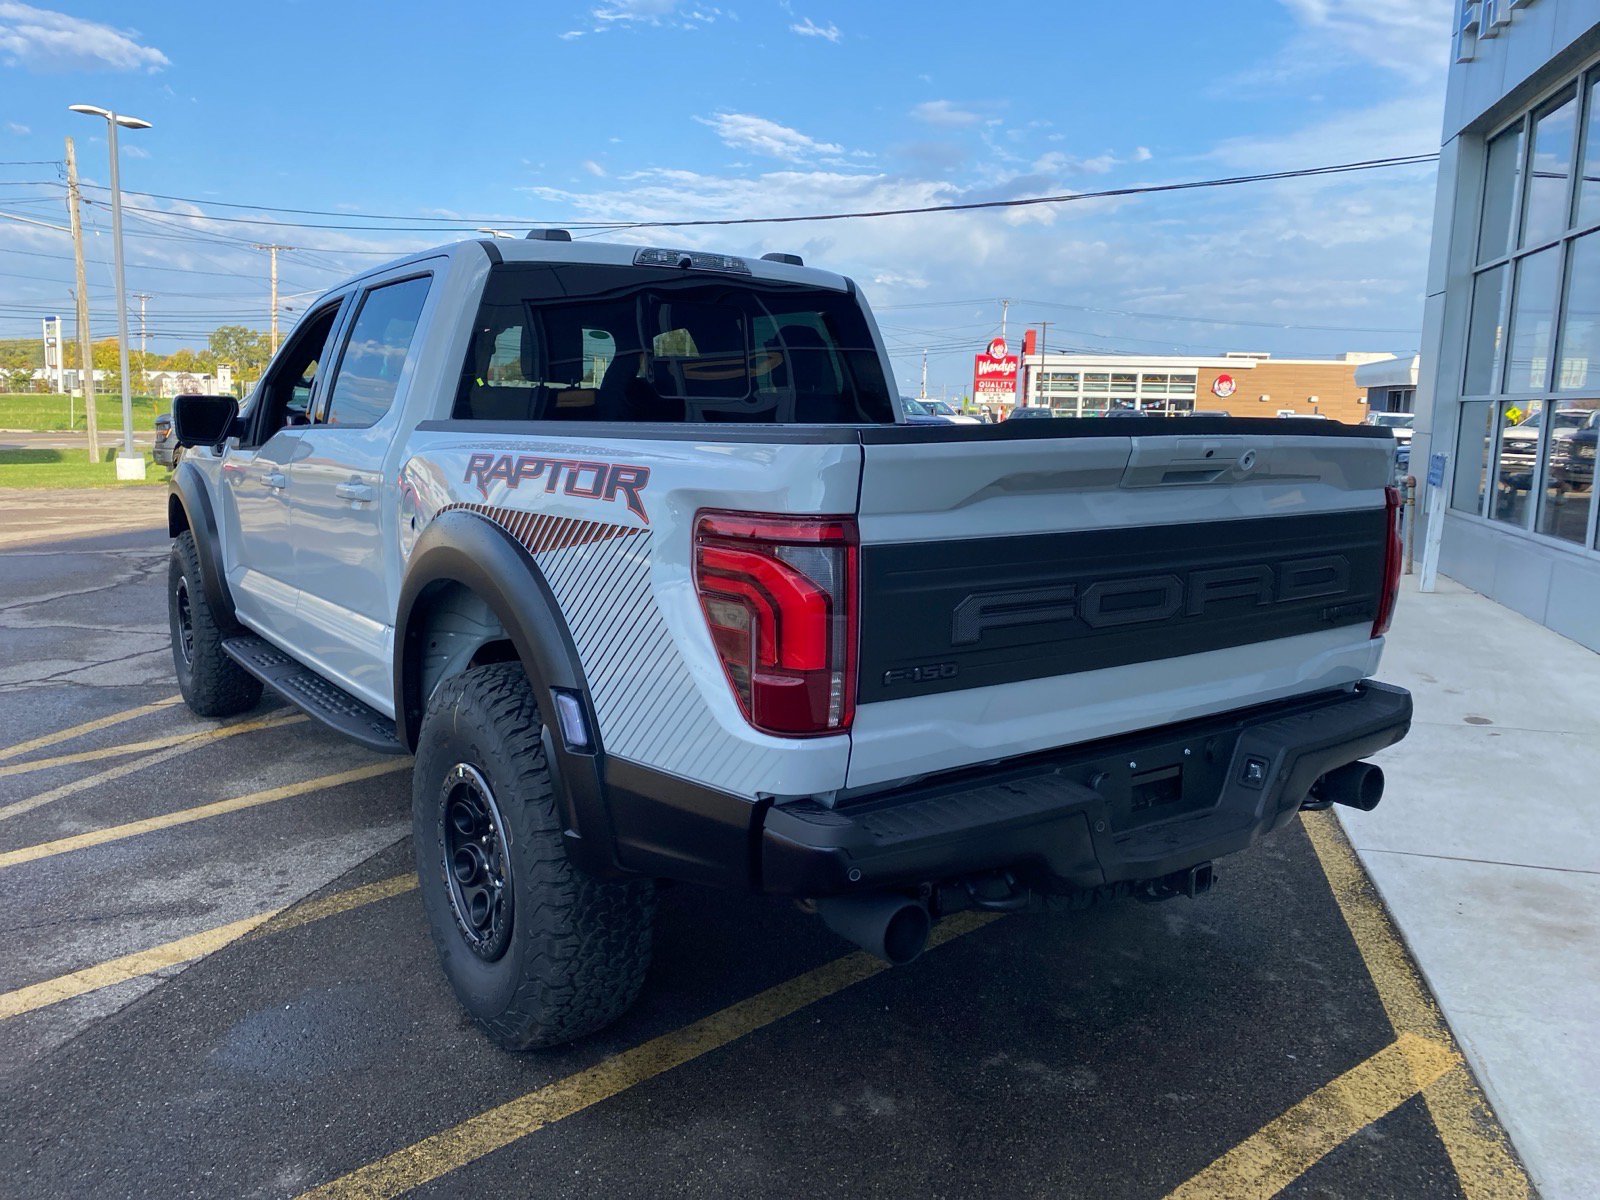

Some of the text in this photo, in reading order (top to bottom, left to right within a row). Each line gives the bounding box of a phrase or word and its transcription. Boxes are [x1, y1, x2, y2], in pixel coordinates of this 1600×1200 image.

[979, 359, 1016, 375] Wendy's
[463, 453, 650, 524] RAPTOR
[952, 555, 1351, 645] FORD
[884, 663, 958, 685] F-150
